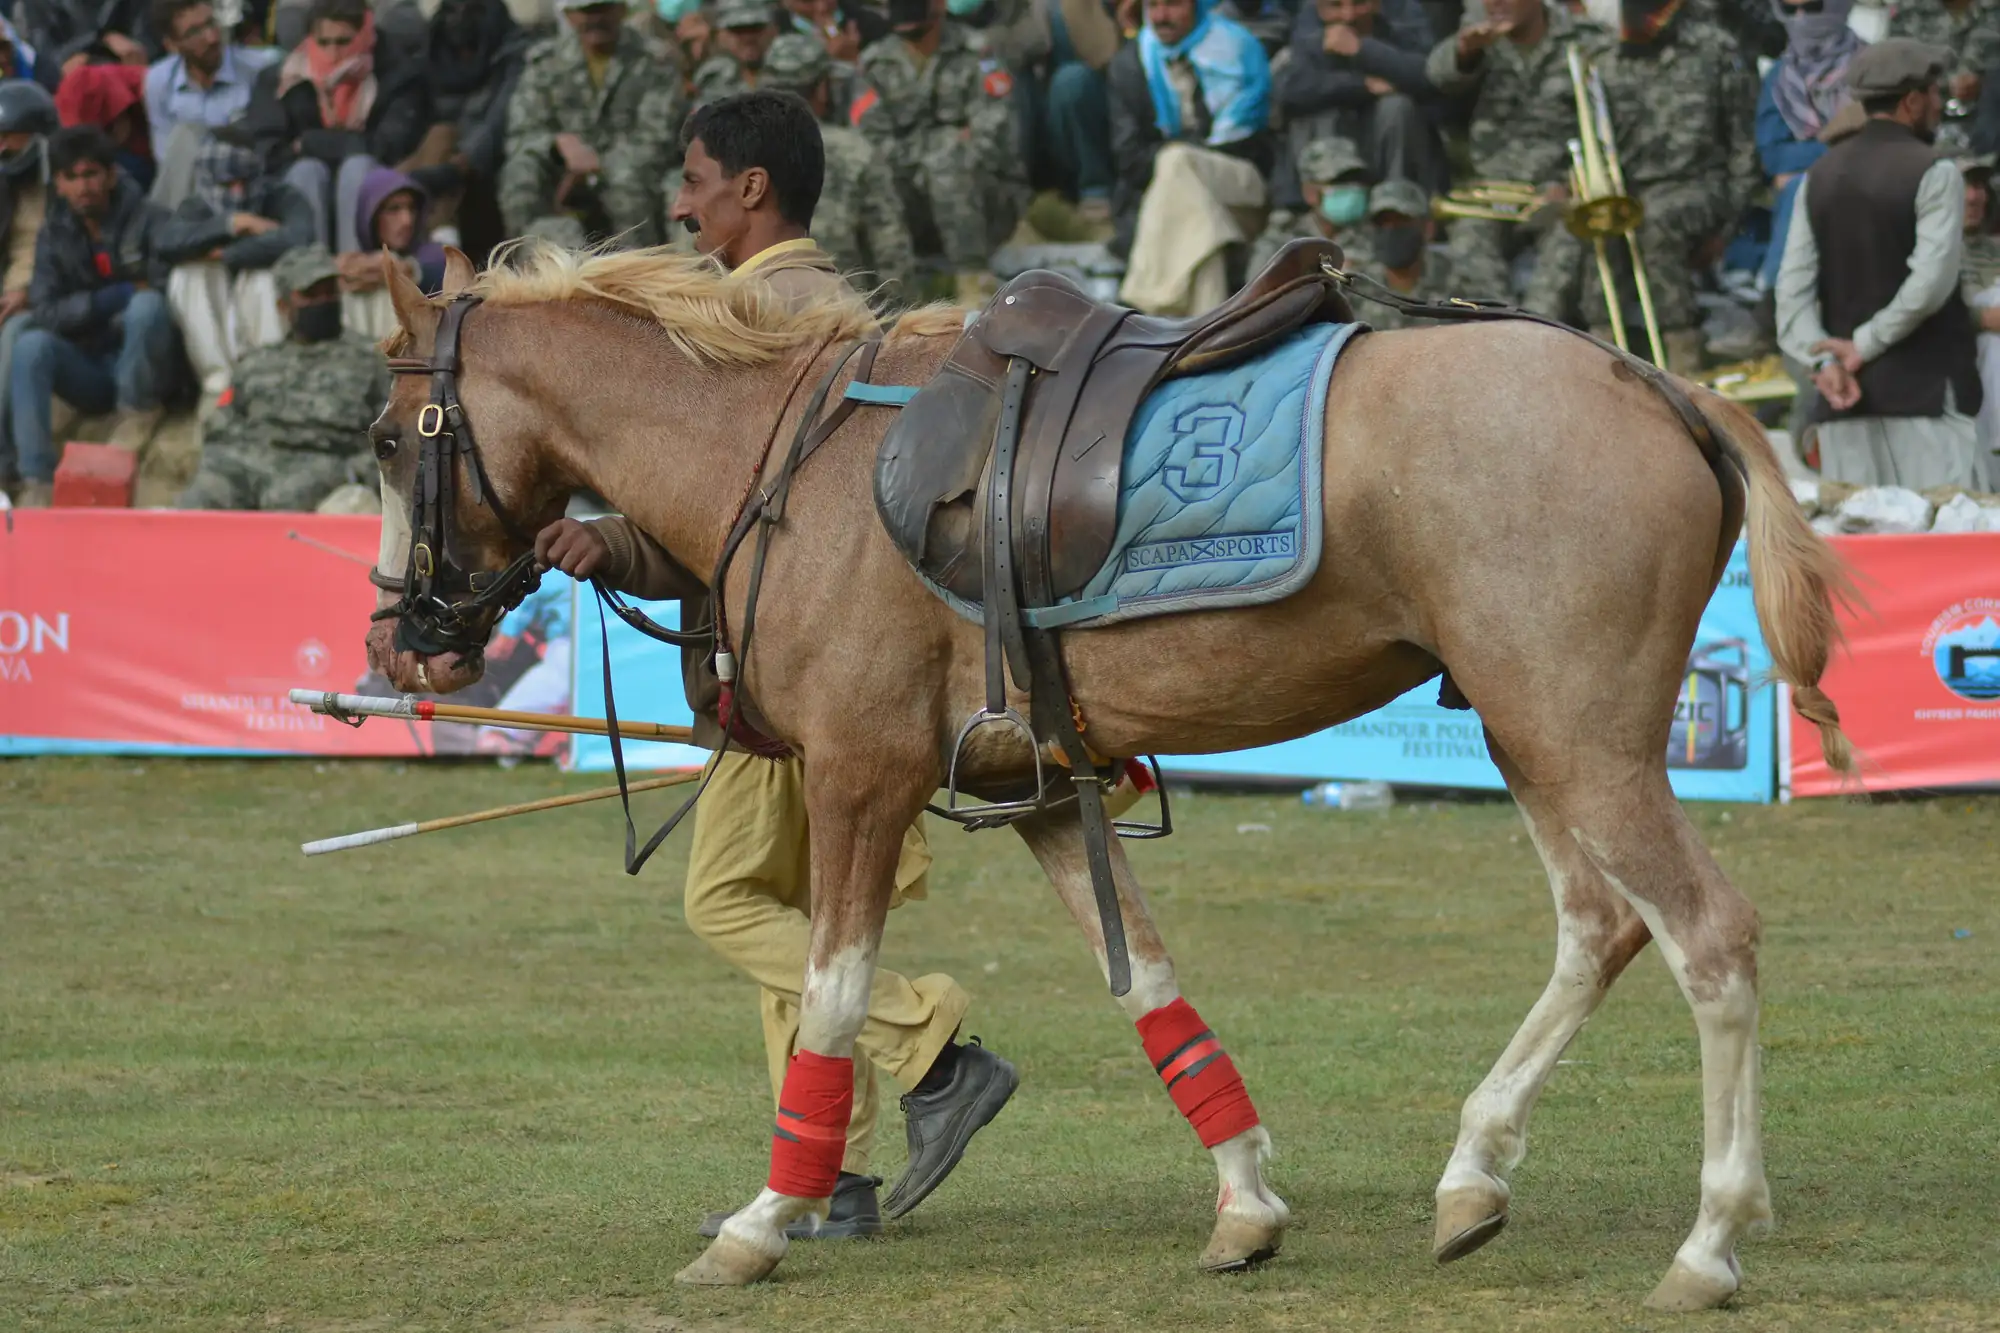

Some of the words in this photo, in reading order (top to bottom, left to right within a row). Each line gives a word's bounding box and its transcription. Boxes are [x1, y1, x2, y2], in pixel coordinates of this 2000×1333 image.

[1162, 402, 1247, 504] 3
[1128, 547, 1192, 568] SCAPA
[1215, 534, 1291, 558] SPORTS
